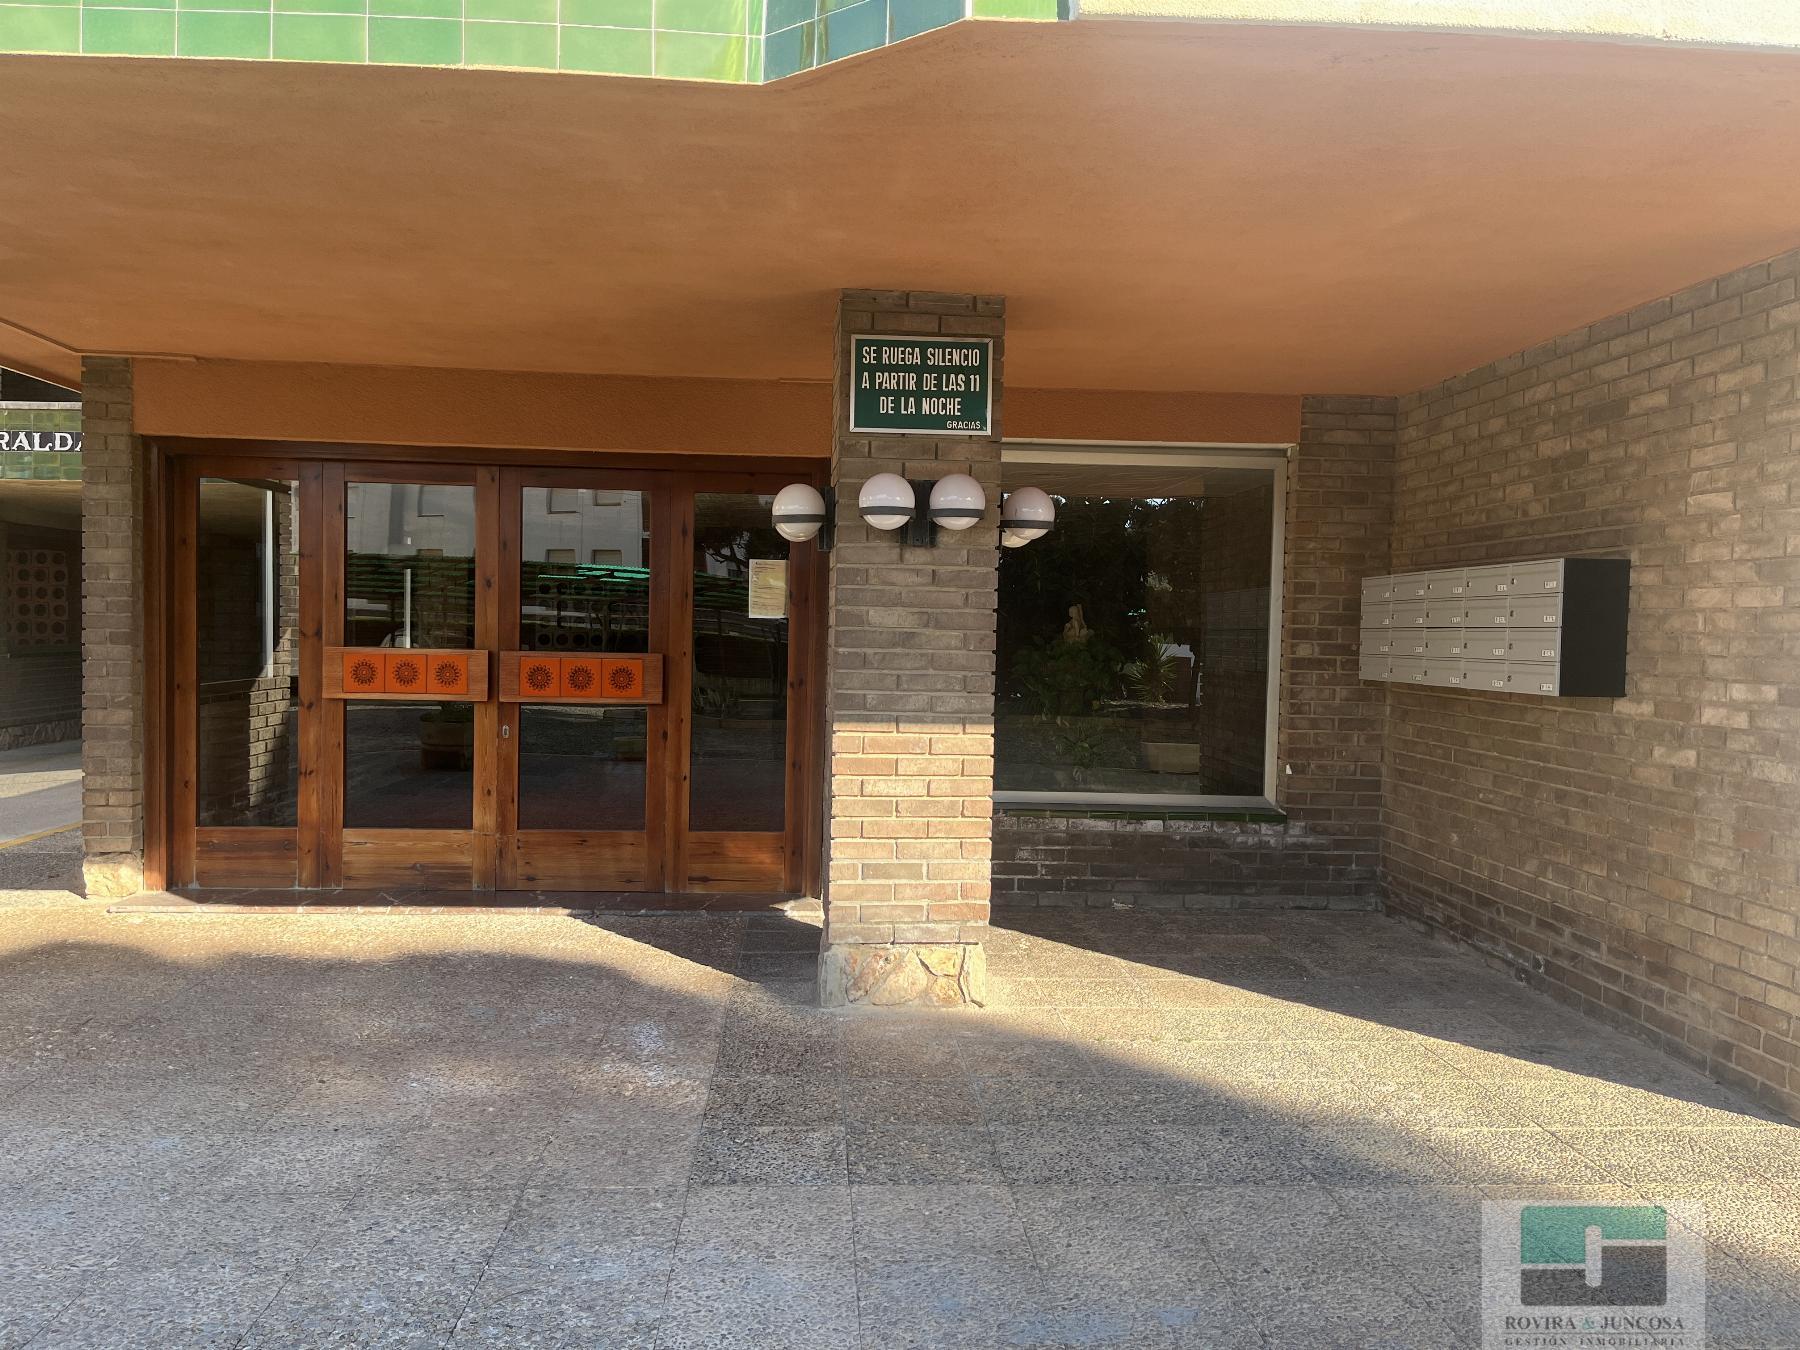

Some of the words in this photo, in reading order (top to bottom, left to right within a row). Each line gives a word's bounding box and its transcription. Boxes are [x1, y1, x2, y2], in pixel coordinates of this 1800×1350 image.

[862, 346, 877, 364] SE
[882, 347, 921, 365] RUEGA
[927, 348, 980, 366] SILENCIO
[862, 372, 870, 389] A
[875, 372, 917, 391] PARTIR
[923, 373, 938, 391] DE
[942, 374, 966, 392] LAS
[969, 374, 980, 392] 11
[879, 396, 895, 414] DE
[901, 397, 916, 415] LA
[922, 397, 962, 416] NOCHE
[946, 420, 981, 430] GRACIAS
